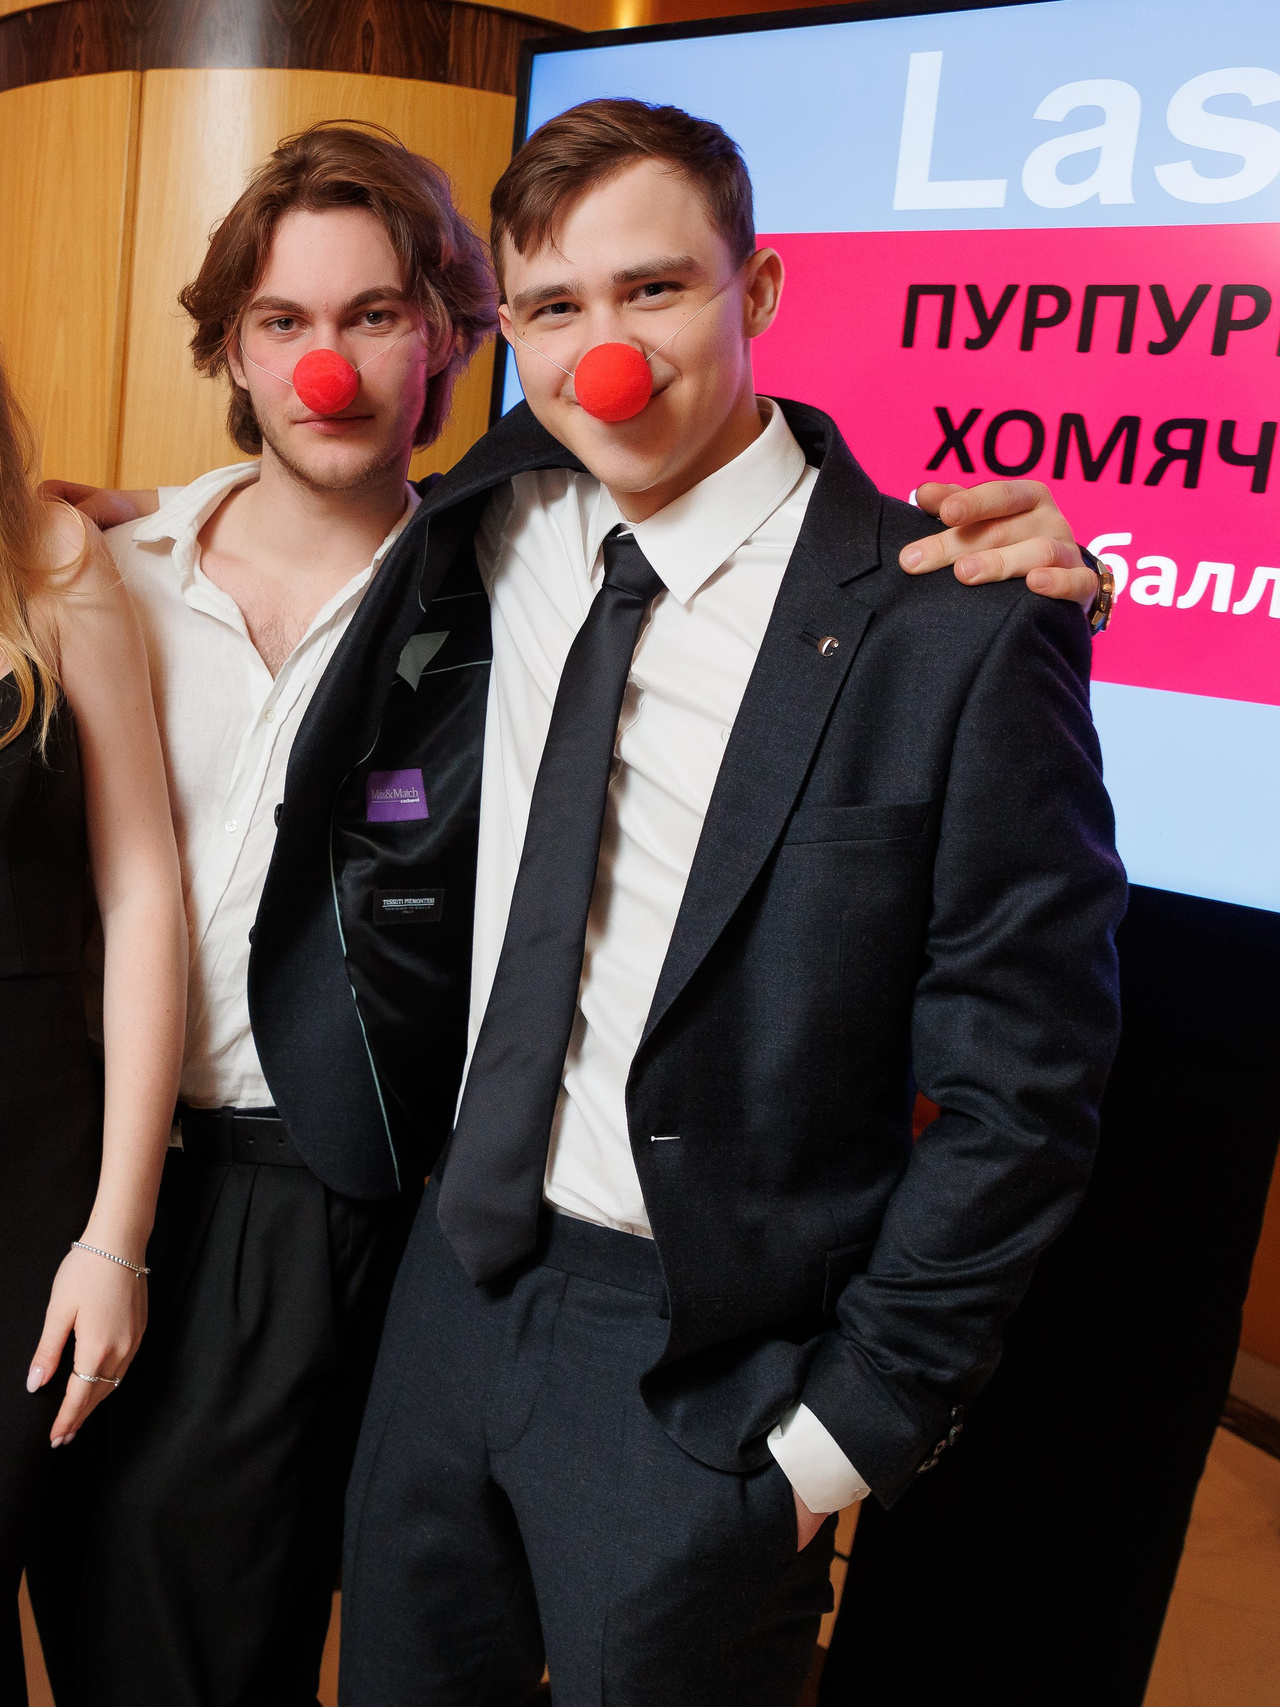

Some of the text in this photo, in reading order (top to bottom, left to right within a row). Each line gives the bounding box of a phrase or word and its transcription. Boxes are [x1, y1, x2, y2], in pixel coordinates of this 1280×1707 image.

[892, 50, 1280, 211] Las
[901, 283, 1280, 357] ПУРПУР
[924, 405, 1278, 494] ХОМЯЧ
[371, 786, 419, 800] Mix&Match
